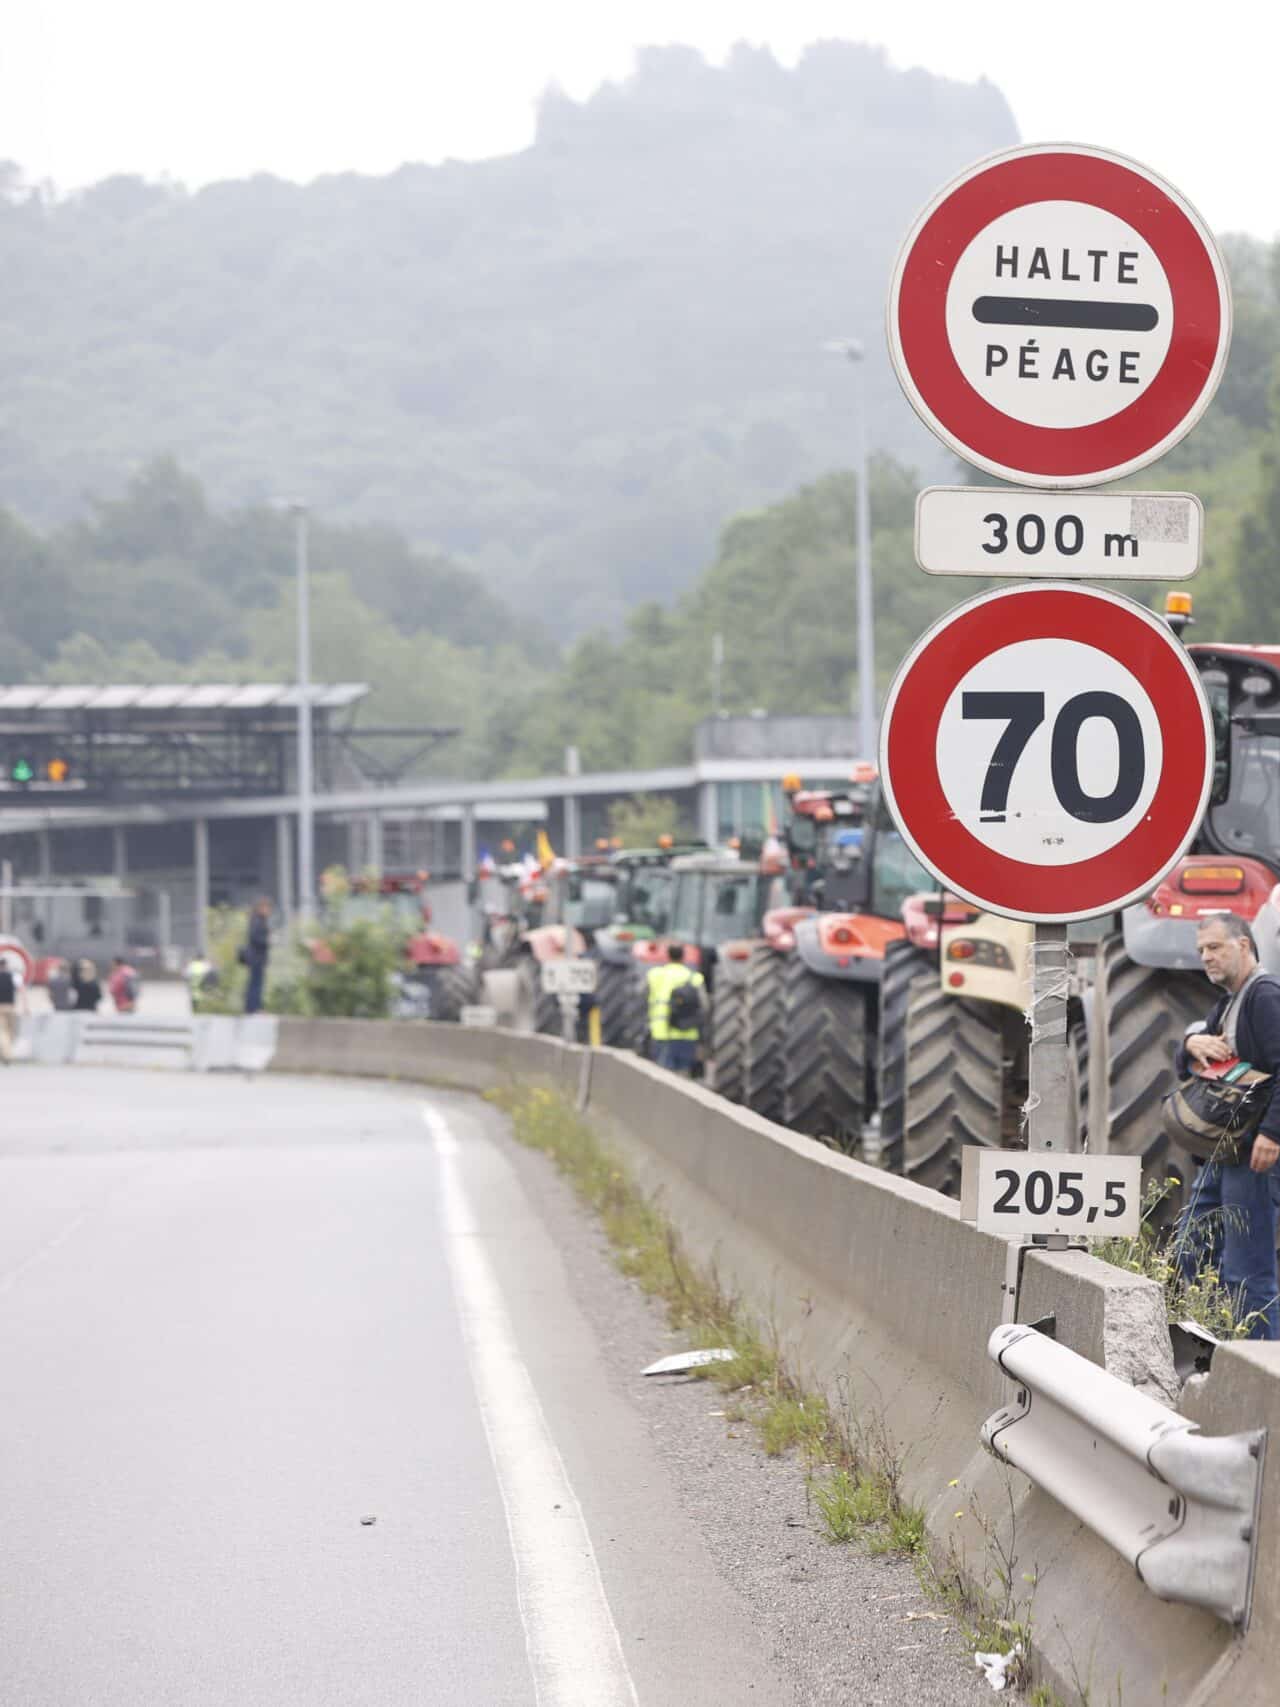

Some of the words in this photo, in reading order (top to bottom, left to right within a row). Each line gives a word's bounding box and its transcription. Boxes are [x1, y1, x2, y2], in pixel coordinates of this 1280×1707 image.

[995, 245, 1139, 284] HALTE
[985, 339, 1141, 384] PÉAGE
[981, 513, 1085, 556] 300
[1104, 532, 1139, 557] m
[962, 690, 1146, 824] 70
[993, 1169, 1127, 1223] 205,5
